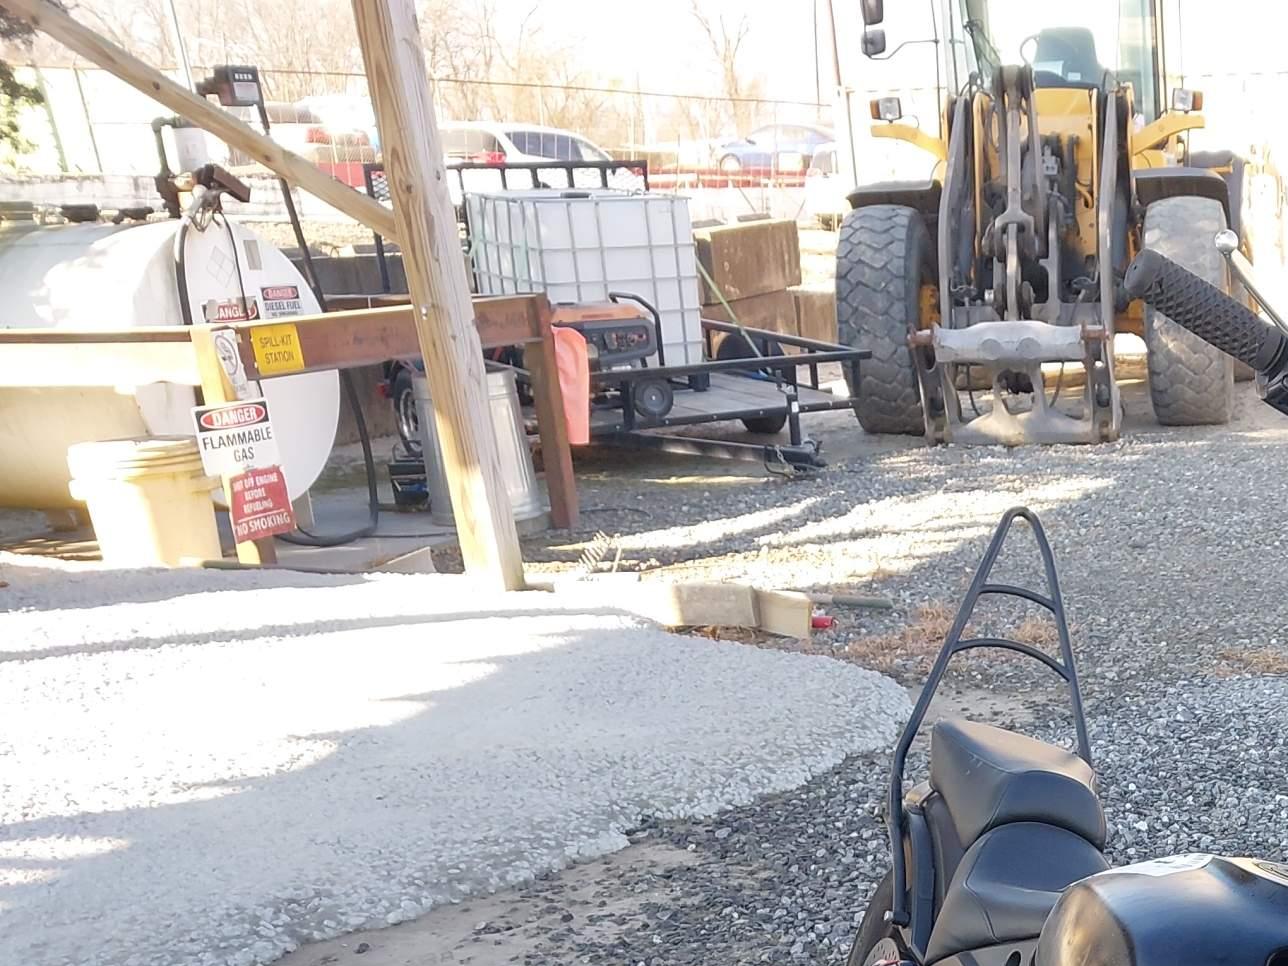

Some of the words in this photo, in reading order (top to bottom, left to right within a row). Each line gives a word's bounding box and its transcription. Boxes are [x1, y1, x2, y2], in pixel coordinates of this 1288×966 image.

[264, 301, 287, 311] DIESEL
[287, 301, 301, 310] FUEL
[260, 334, 292, 348] SPILL-KIT
[265, 351, 295, 364] STATION
[212, 407, 258, 427] DANGER
[202, 426, 273, 450] FLAMMABLE
[234, 446, 255, 462] GAS
[235, 525, 249, 536] NO
[249, 512, 290, 532] SMOKING
